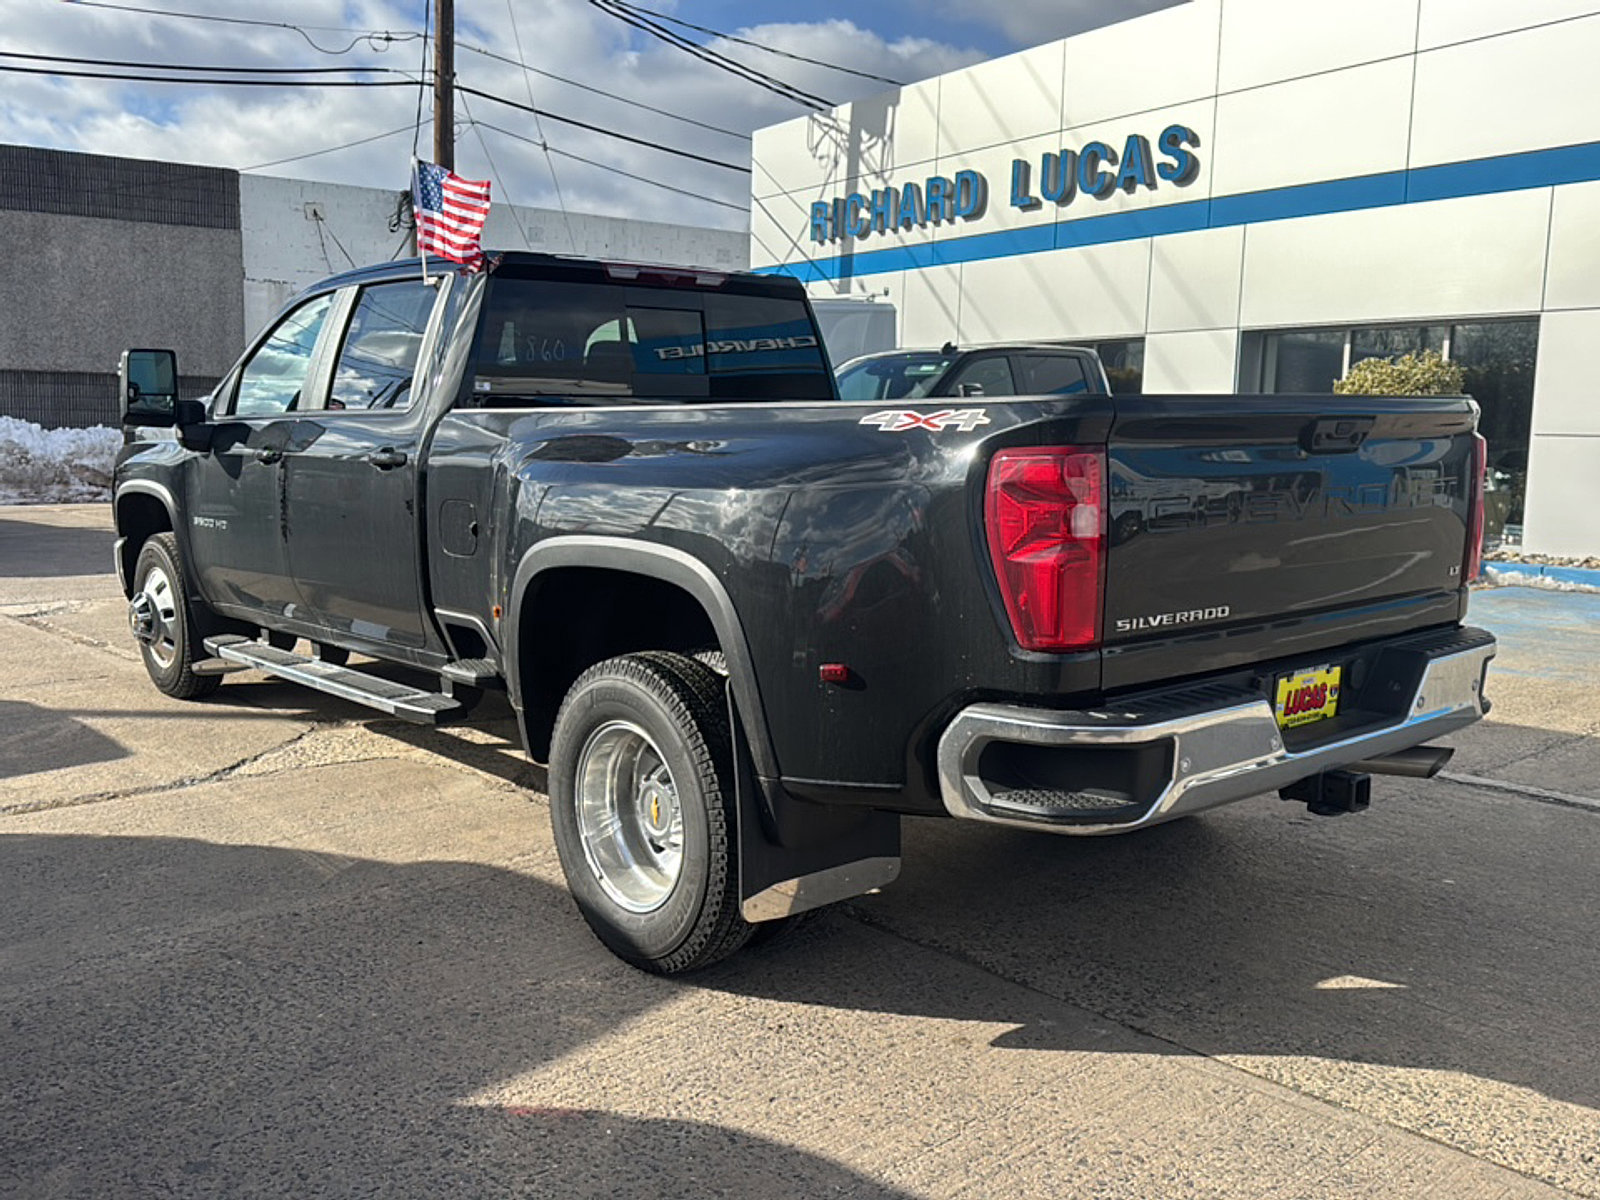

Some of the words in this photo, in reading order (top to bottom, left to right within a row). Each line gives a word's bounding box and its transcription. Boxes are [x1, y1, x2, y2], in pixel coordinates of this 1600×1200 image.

[810, 169, 987, 245] RICHARD
[1010, 124, 1200, 212] LUCAS
[1116, 605, 1230, 632] SILVERADO
[1284, 682, 1328, 716] LUCAS
